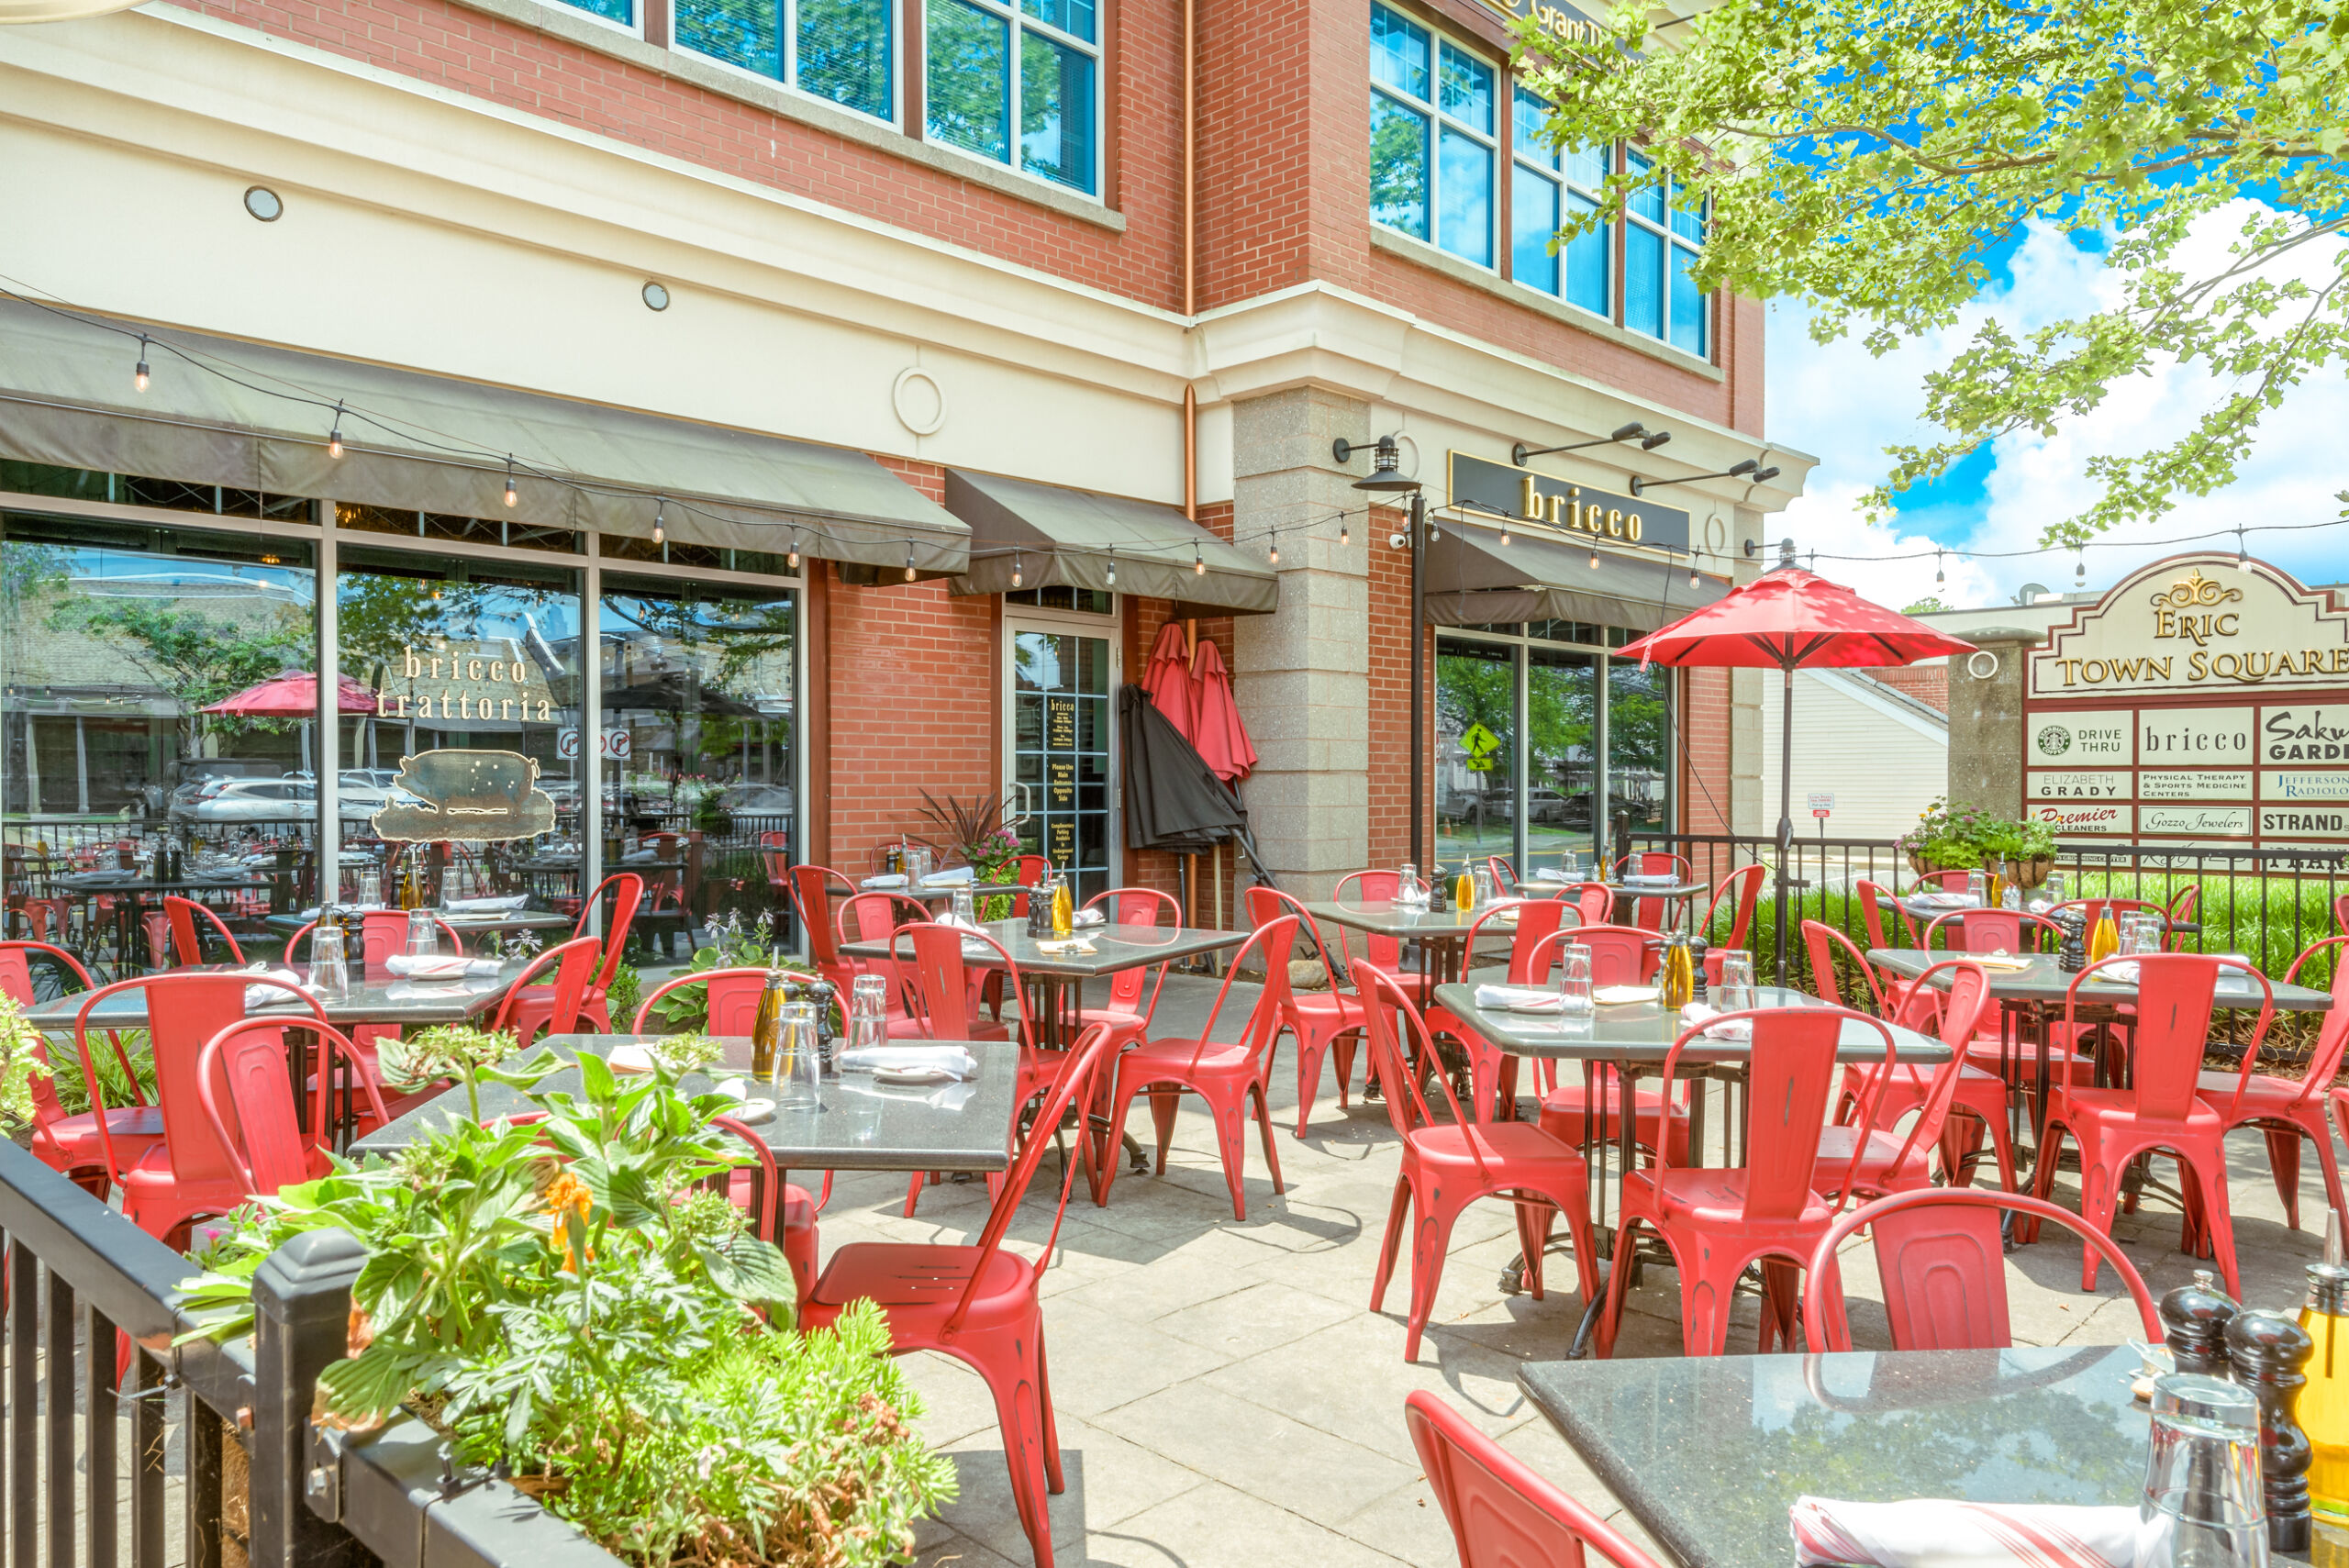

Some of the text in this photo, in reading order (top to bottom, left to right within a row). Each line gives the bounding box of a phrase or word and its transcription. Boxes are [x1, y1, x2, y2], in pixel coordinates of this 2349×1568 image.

[1523, 474, 1642, 541] bricco
[2154, 609, 2240, 647] ERIC
[404, 644, 527, 683] bricco
[2055, 649, 2349, 686] TOWN SQUARE
[375, 686, 551, 721] trattoria
[1051, 698, 1074, 711] bricco
[2078, 729, 2122, 740] DRIVE
[2146, 726, 2246, 751] bricco
[2080, 742, 2121, 752] THRU
[2043, 774, 2114, 784] ELIZABETH
[2041, 786, 2116, 796] GRADY
[2040, 807, 2118, 825] Premier
[2145, 811, 2243, 830] Gozzo Jewelers
[2264, 814, 2343, 830] STRAND
